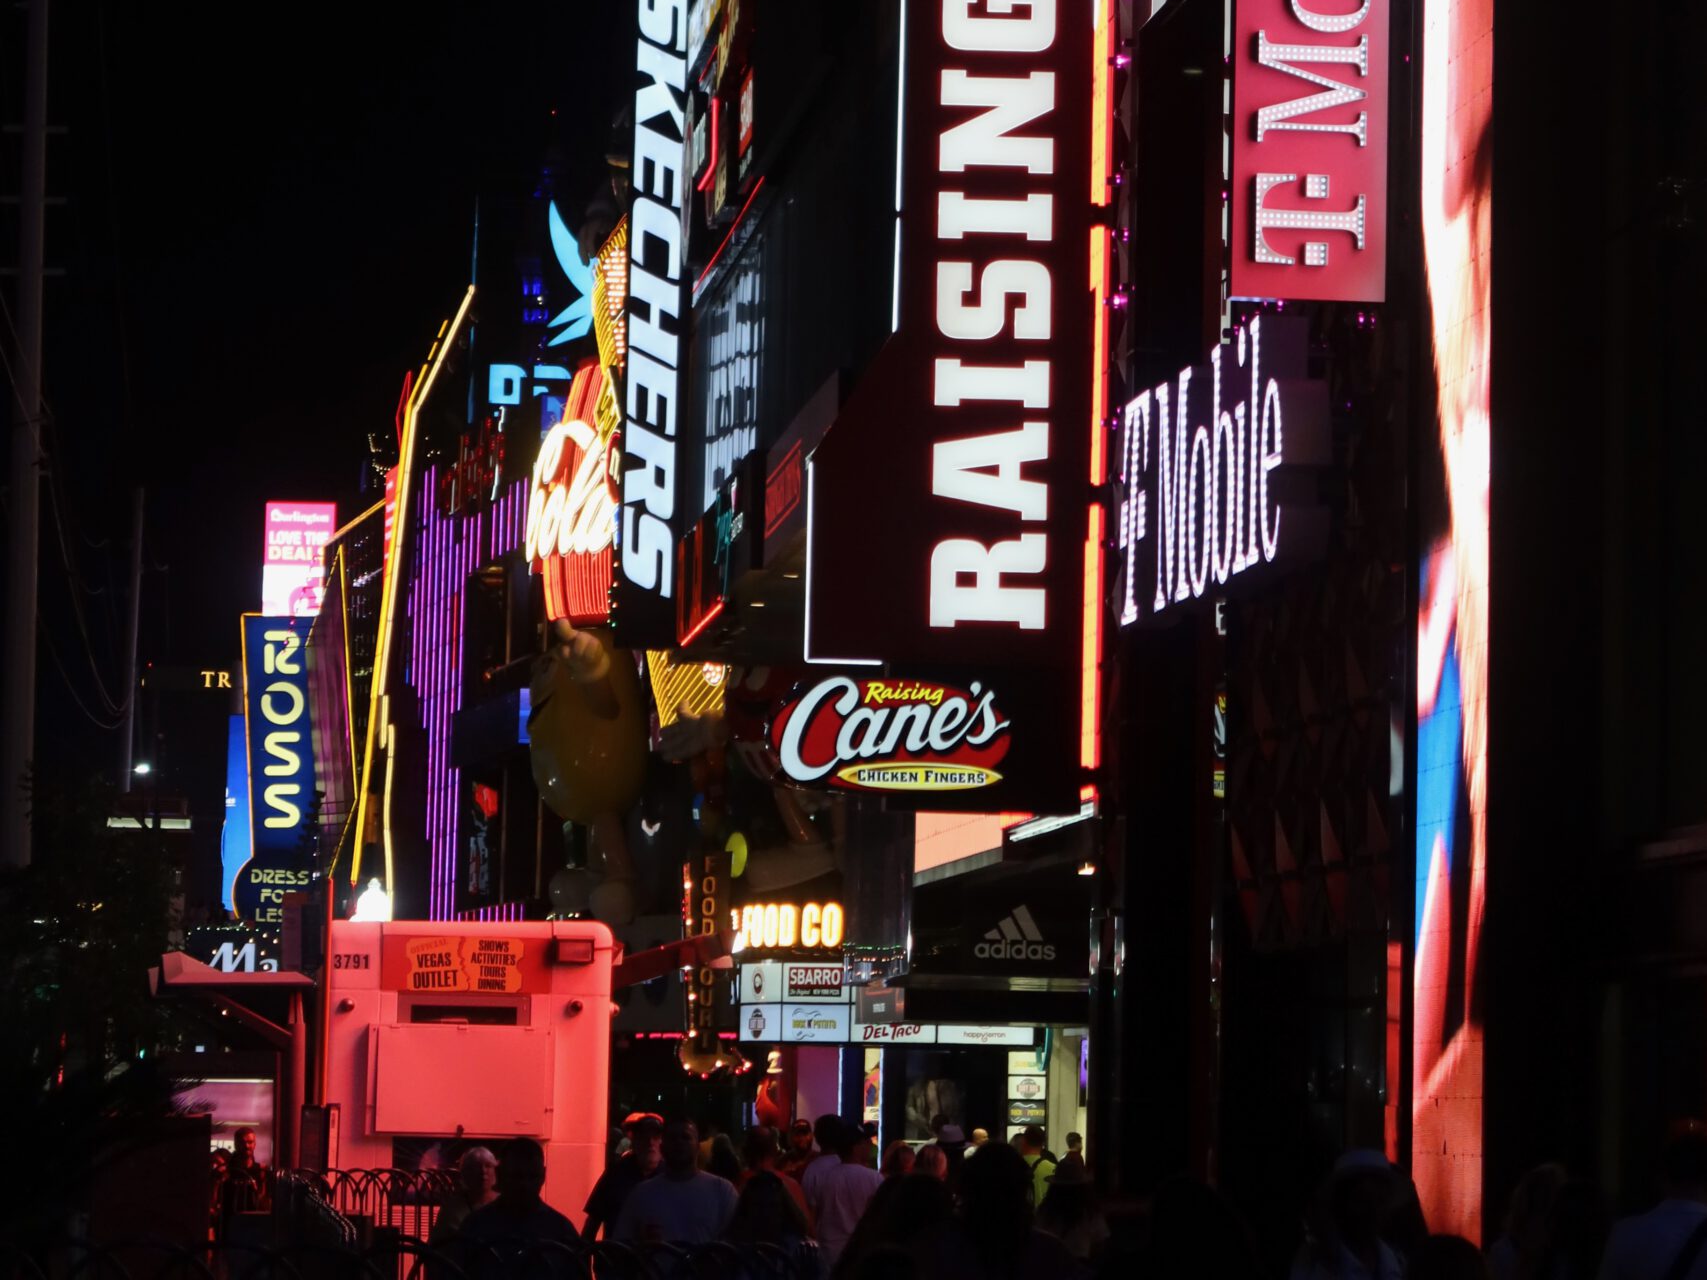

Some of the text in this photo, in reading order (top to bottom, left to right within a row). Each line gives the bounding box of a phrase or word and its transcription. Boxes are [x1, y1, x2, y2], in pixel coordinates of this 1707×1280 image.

[268, 531, 301, 545] LOVE
[863, 681, 945, 706] Raising
[261, 630, 304, 828] ROSS
[780, 676, 1011, 781] Cane's
[856, 769, 986, 784] CHICKEN FINGERS
[250, 869, 310, 885] DRESS
[260, 889, 297, 903] FO
[741, 904, 797, 947] FOOD
[479, 939, 509, 952] SHOWS
[974, 939, 1056, 960] adidas
[334, 954, 370, 969] 3791
[417, 953, 452, 968] VEGAS
[470, 952, 516, 966] ACTIVITIES
[413, 970, 458, 989] OUTLET
[479, 966, 506, 978] TOURS
[789, 970, 841, 986] SBARRO
[478, 978, 506, 990] DINING
[863, 1023, 921, 1040] DEL TACO
